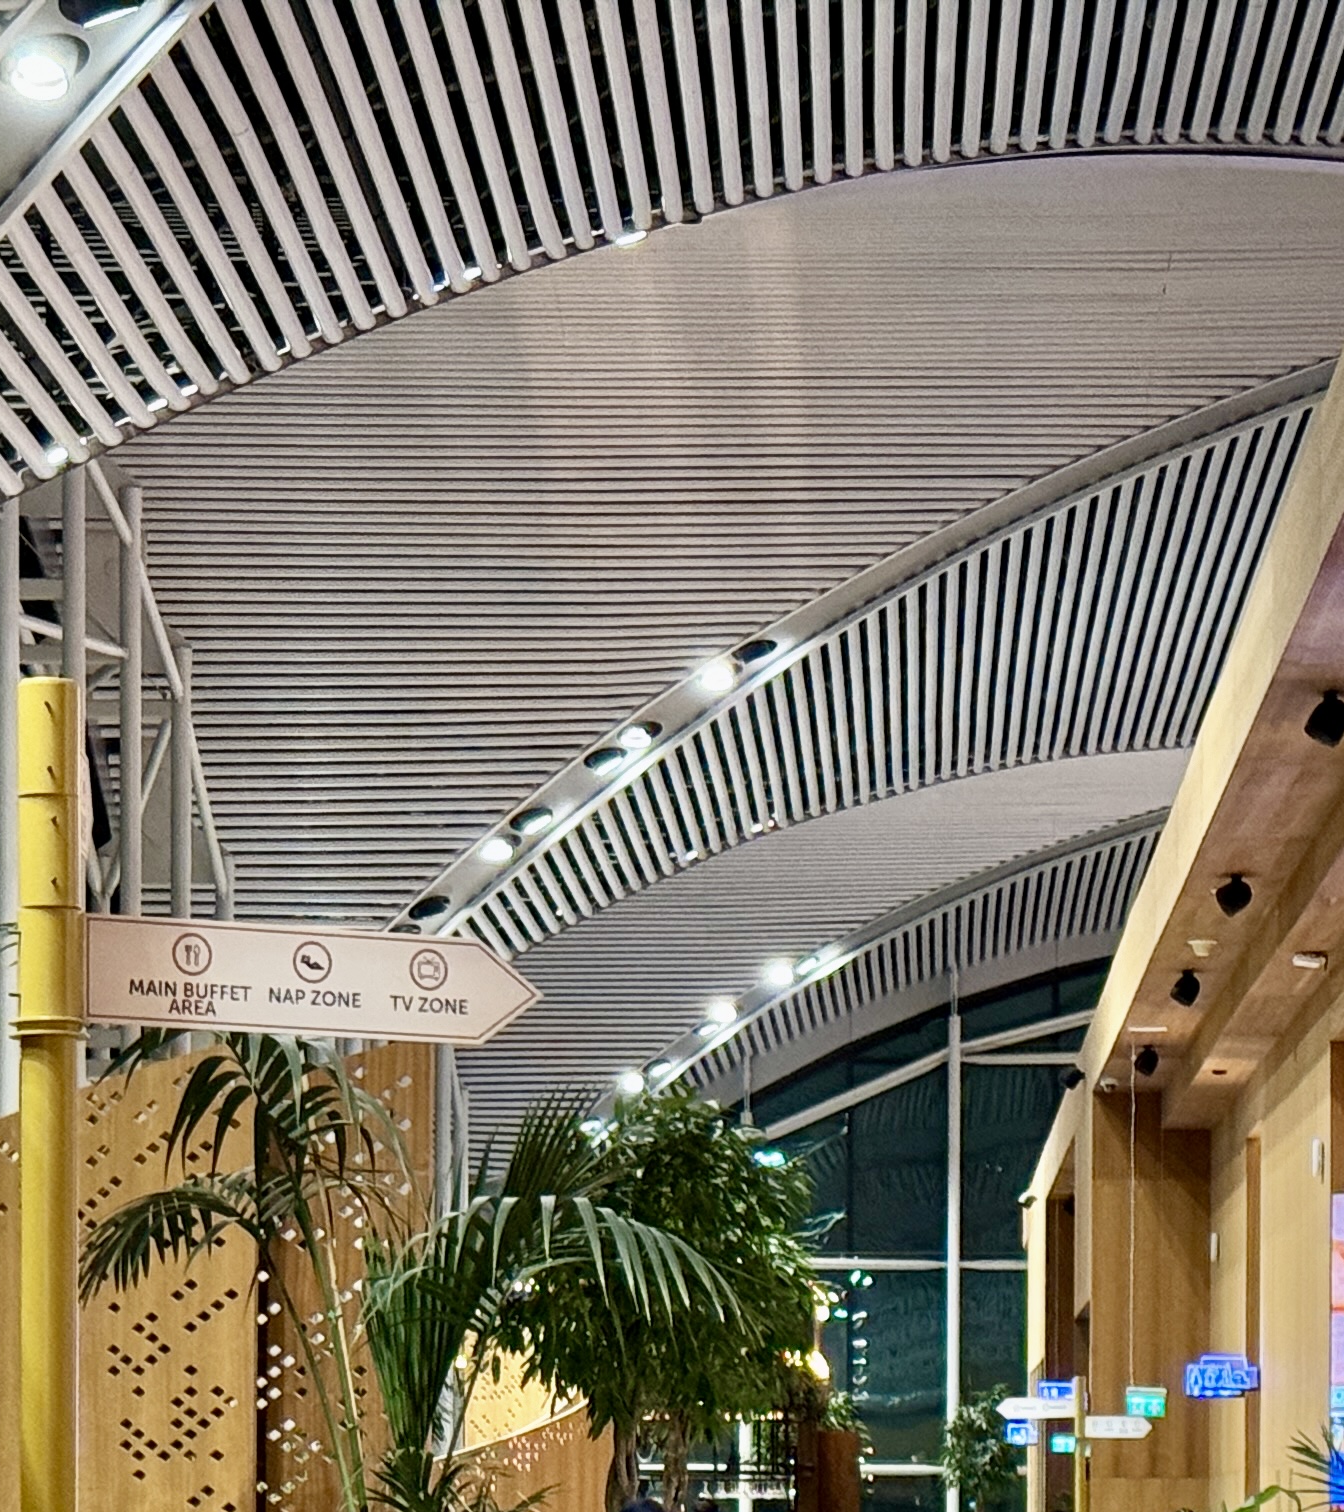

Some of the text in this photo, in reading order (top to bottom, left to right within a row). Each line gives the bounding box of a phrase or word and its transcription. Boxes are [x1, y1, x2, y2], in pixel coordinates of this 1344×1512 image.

[128, 978, 253, 1002] MAIN BUFFET
[268, 987, 362, 1009] NAP ZONE
[168, 998, 217, 1017] AREA
[389, 994, 469, 1015] TV ZONE
